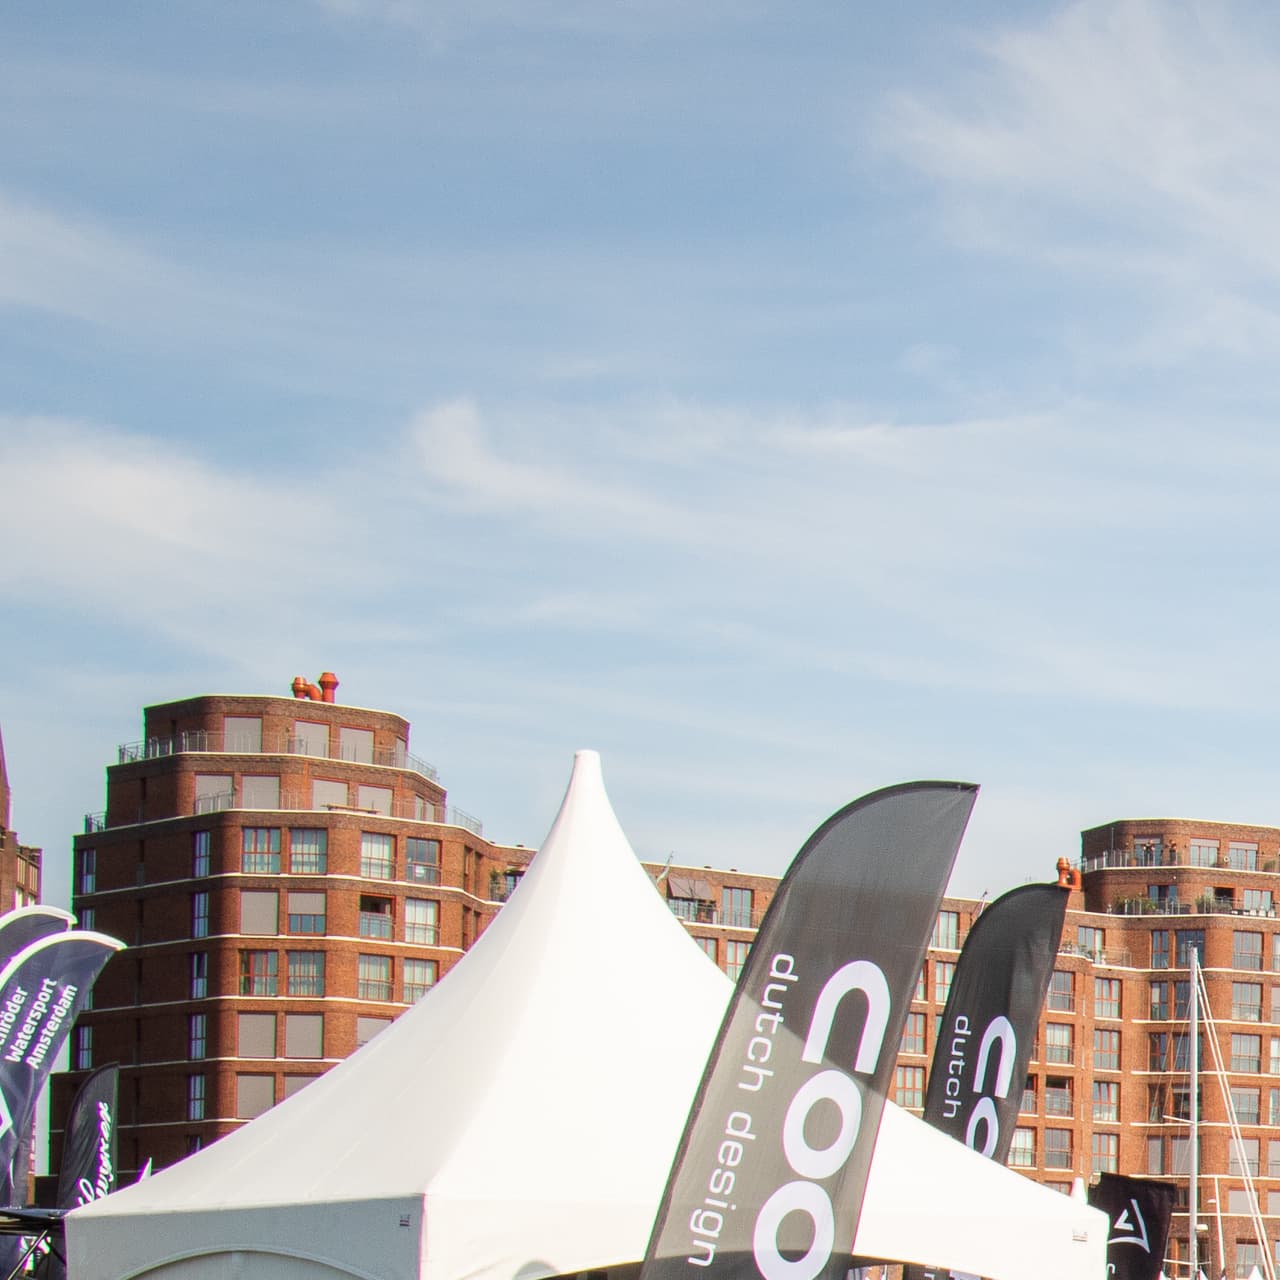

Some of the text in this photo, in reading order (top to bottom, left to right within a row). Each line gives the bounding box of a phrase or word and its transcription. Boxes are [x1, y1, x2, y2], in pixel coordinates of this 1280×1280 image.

[5, 977, 58, 1063] Watersport
[26, 984, 78, 1070] Amsterdam
[738, 953, 799, 1092] dutch
[943, 1015, 972, 1119] dutch
[688, 1111, 757, 1268] design
